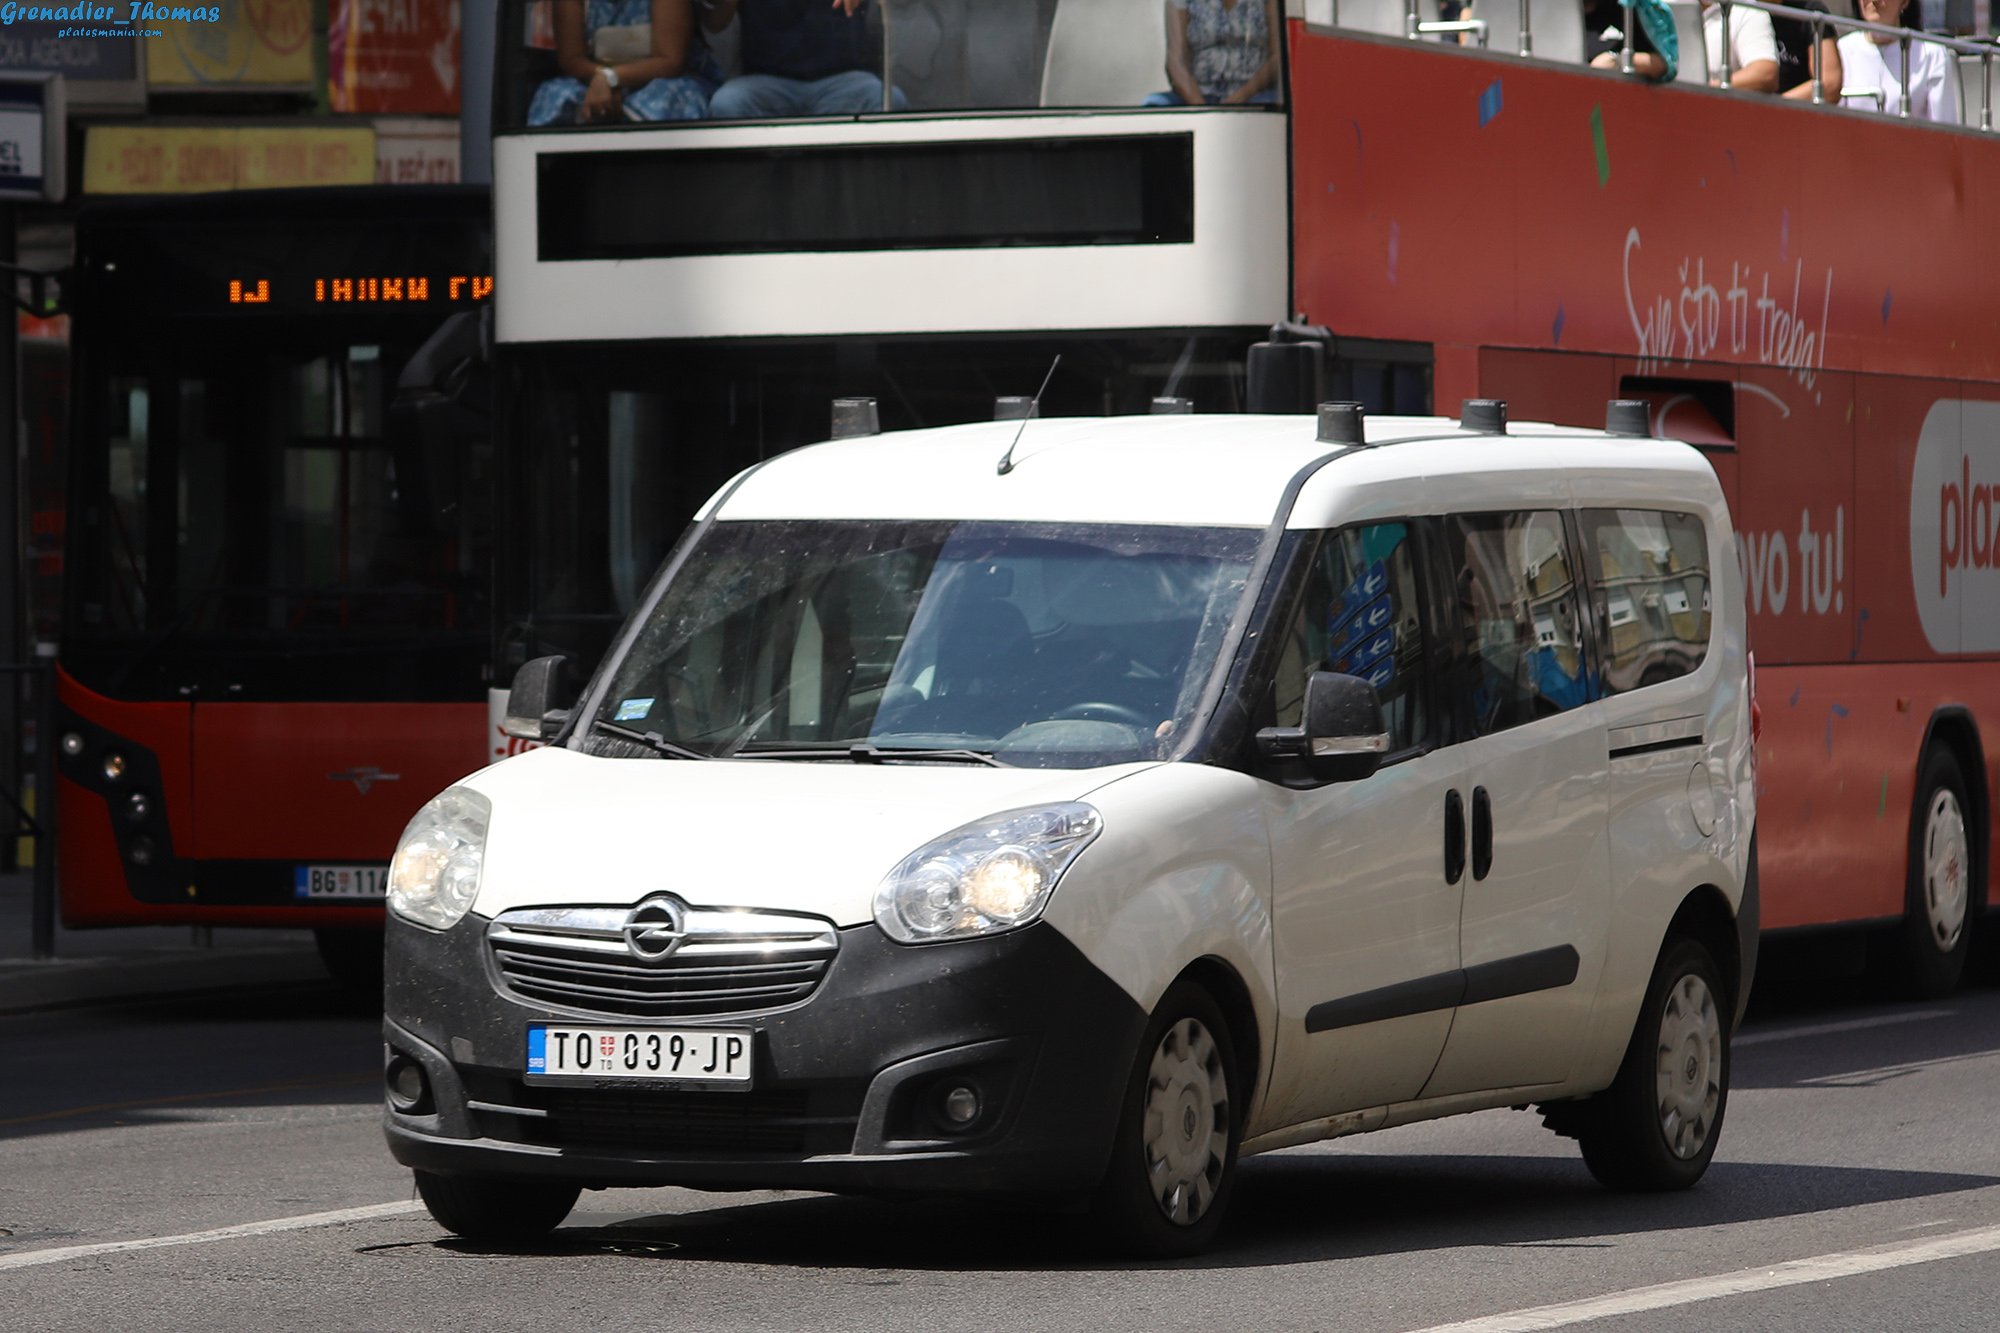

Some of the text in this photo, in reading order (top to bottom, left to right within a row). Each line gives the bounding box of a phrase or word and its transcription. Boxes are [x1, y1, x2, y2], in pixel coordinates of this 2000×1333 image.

[1624, 226, 1676, 376] Sve
[1679, 256, 1720, 370] što
[1727, 261, 1749, 355] ti
[1798, 503, 1844, 615] tu!
[312, 870, 336, 893] BG
[553, 1032, 592, 1070] TO
